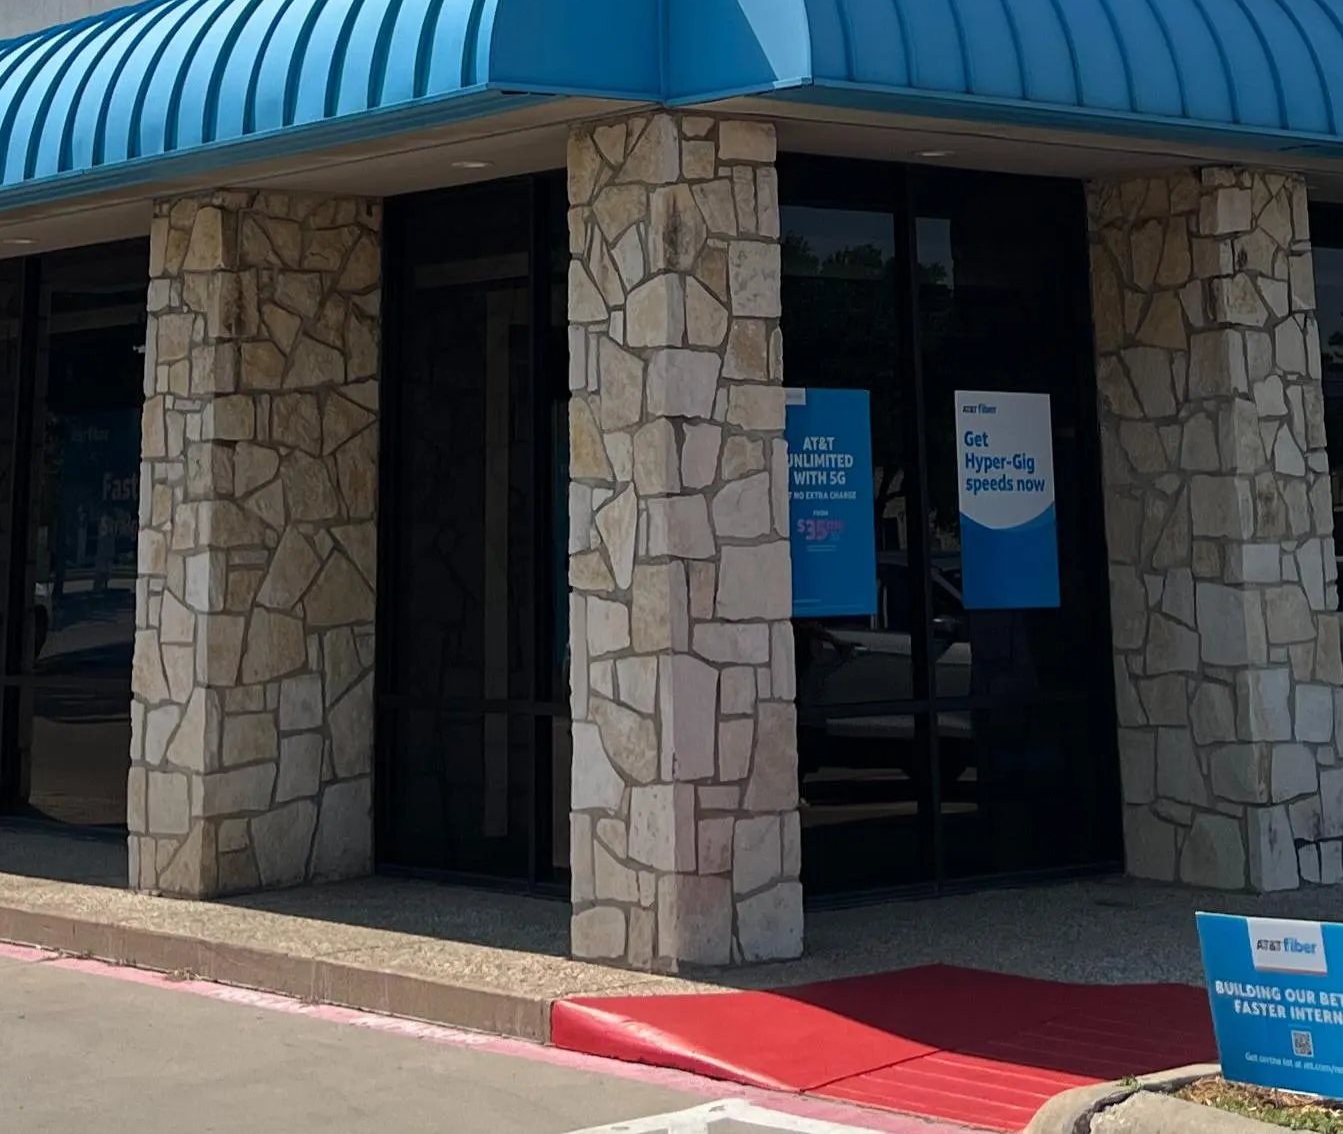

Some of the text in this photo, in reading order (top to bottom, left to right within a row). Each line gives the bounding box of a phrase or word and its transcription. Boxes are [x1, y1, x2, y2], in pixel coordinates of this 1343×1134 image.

[802, 435, 835, 451] AT&T
[964, 430, 989, 448] Get
[964, 452, 1036, 475] Hyper-Gig
[793, 470, 847, 486] WITH 5G
[966, 473, 1046, 496] speeds now
[806, 491, 829, 500] EXTRA
[1256, 937, 1317, 955] AT&T fiber
[1214, 979, 1282, 1002] BUILDING
[1284, 988, 1317, 1005] OUR
[1234, 998, 1287, 1019] FASTER
